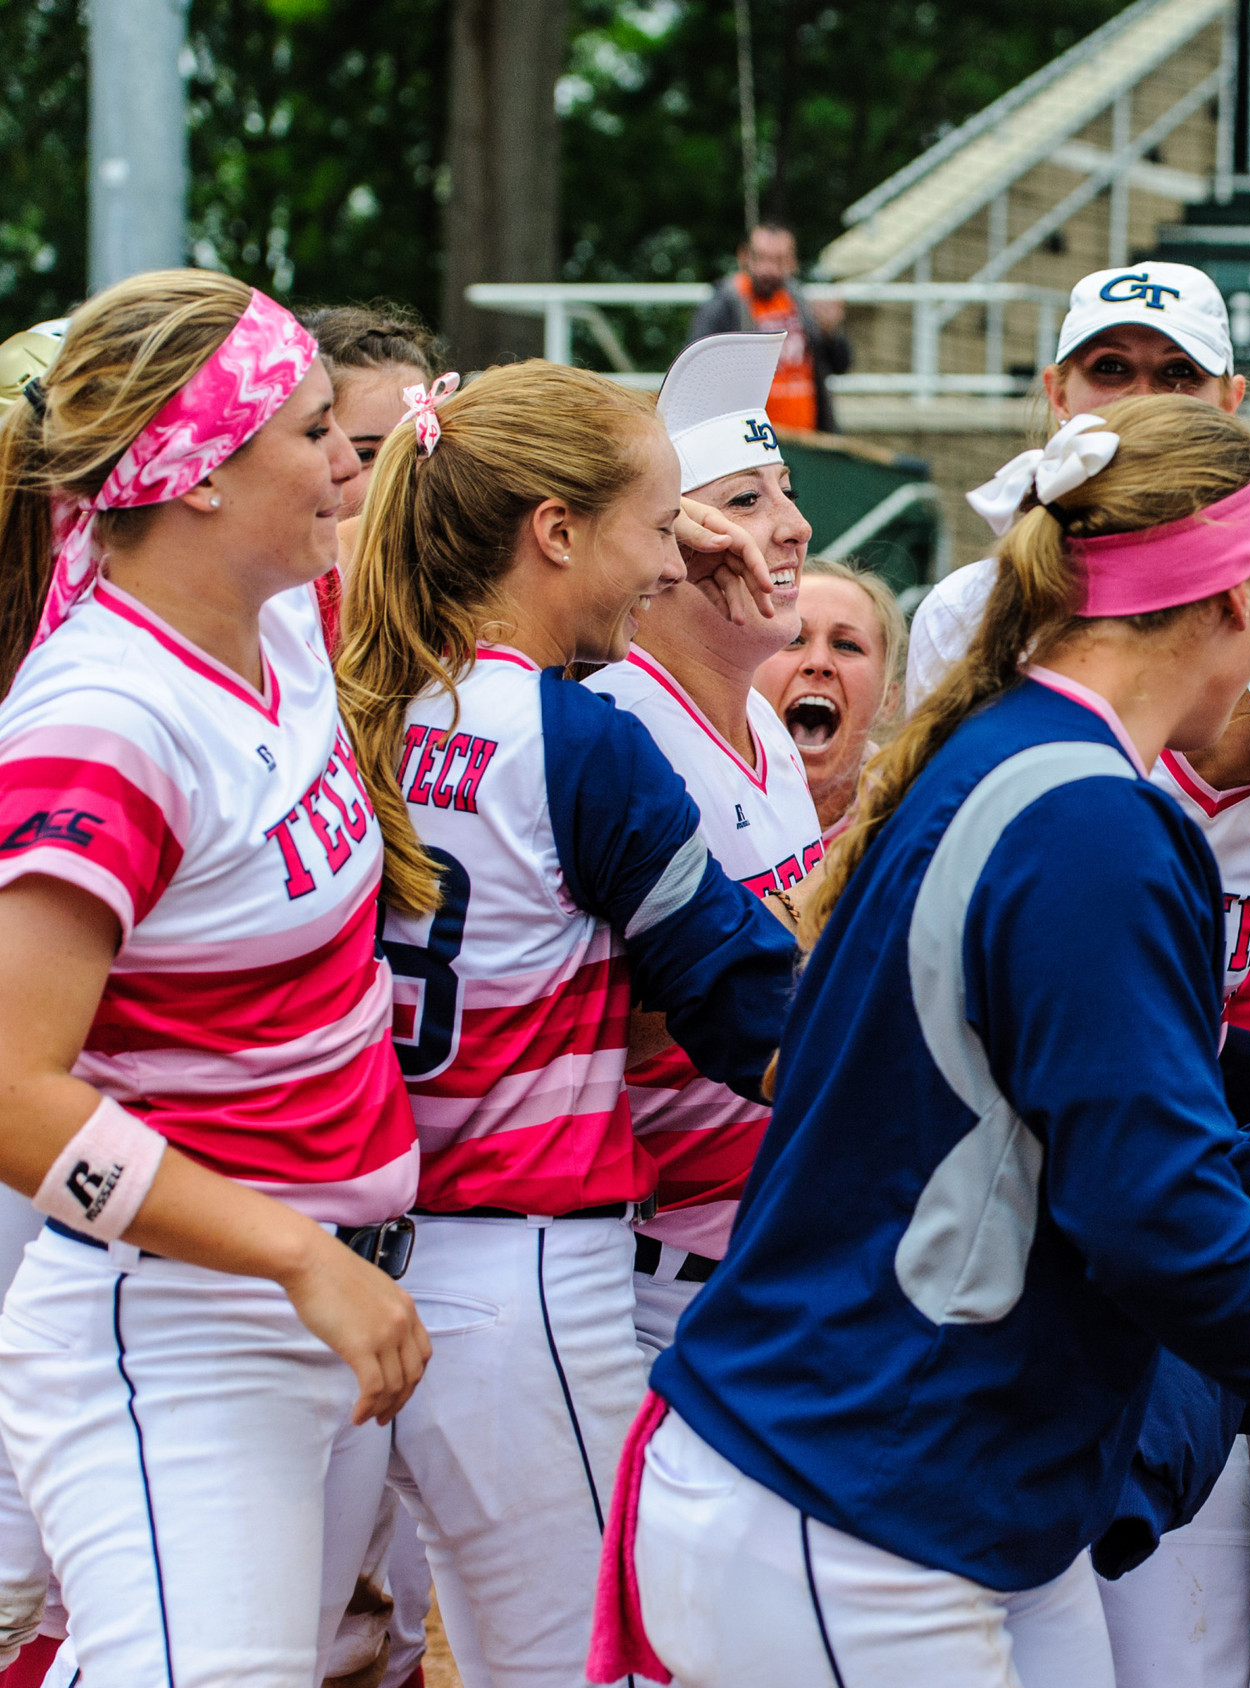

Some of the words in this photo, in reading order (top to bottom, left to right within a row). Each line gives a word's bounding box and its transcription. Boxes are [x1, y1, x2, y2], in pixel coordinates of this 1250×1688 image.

[1099, 272, 1181, 311] GT
[743, 418, 778, 451] GT
[395, 723, 499, 815] TECH
[66, 1159, 104, 1210] R
